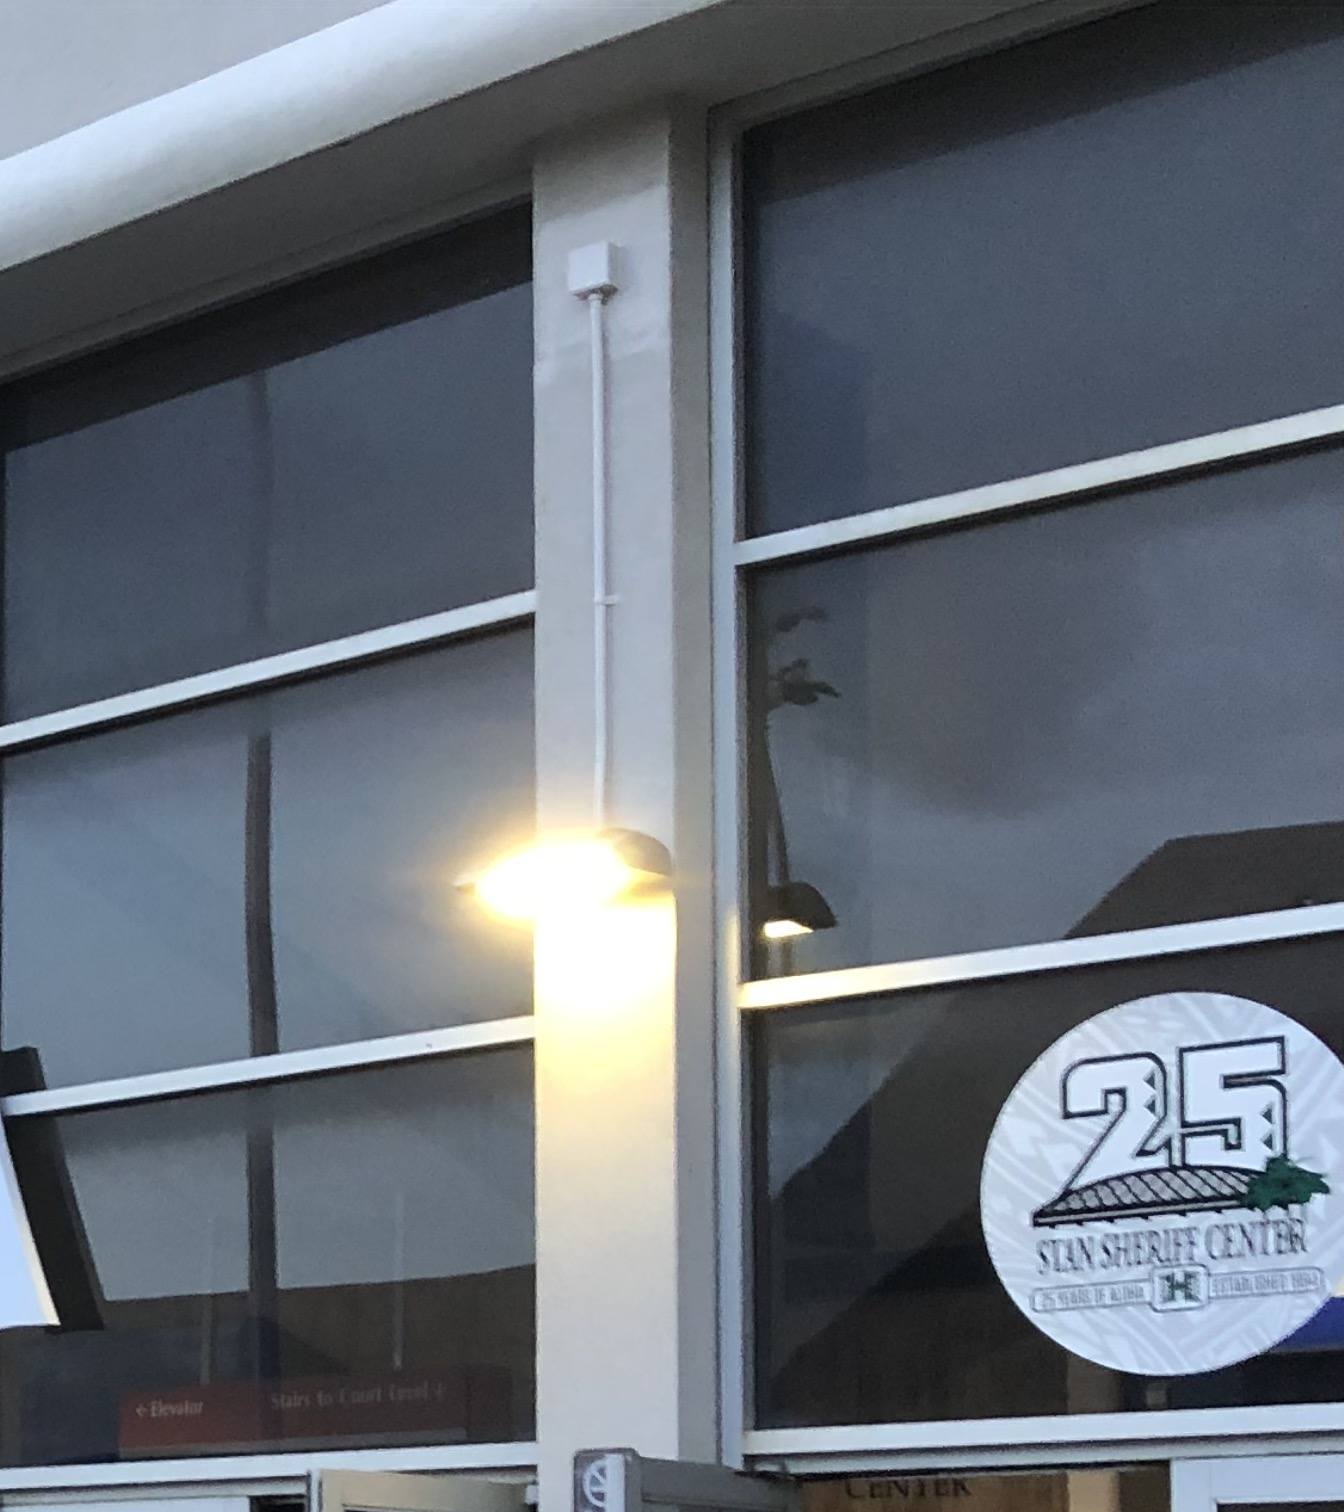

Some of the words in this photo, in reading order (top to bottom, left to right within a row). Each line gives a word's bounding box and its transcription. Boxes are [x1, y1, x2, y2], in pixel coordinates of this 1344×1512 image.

[1040, 1035, 1289, 1210] 25
[1036, 1237, 1097, 1275] STAN
[1100, 1226, 1200, 1269] SHERIFF
[1204, 1217, 1309, 1260] CENTER
[150, 1399, 204, 1418] Elevator
[317, 1389, 334, 1407] to
[845, 1477, 973, 1499] CENTER
